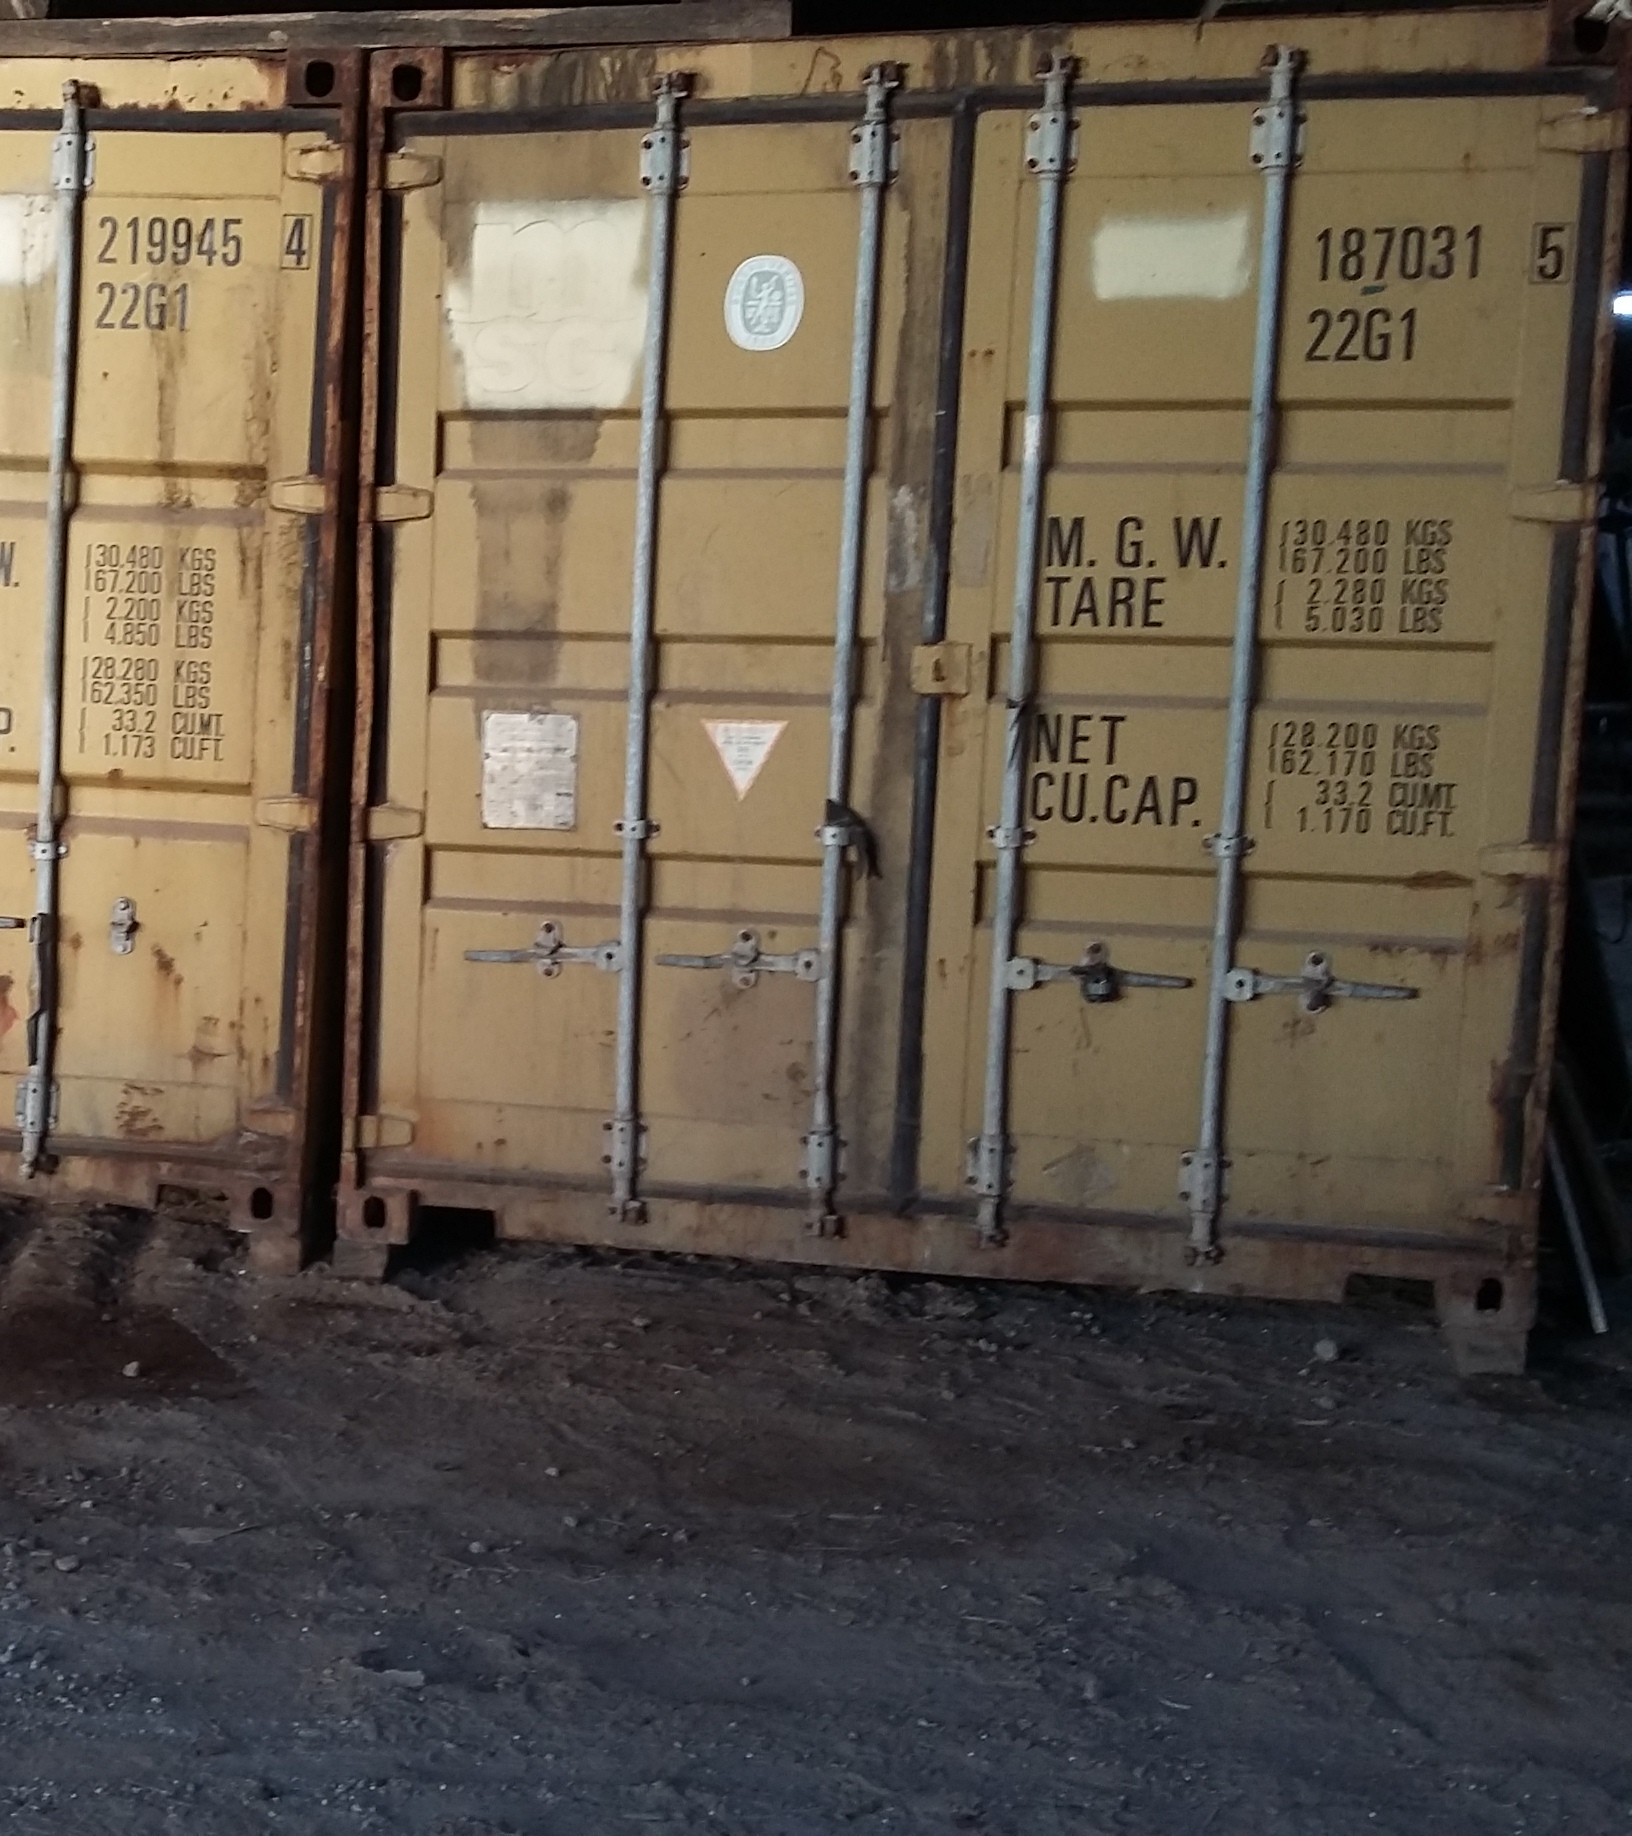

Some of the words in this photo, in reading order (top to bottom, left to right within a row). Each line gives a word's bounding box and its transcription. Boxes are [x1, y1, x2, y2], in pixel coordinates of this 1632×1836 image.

[98, 216, 242, 267] 219945
[285, 217, 306, 266] 4
[1316, 224, 1483, 282] 187031
[1534, 226, 1566, 280] 5
[96, 282, 189, 332] 22G1
[1305, 306, 1417, 362] 22G1
[1293, 519, 1389, 547] 30.480
[1405, 519, 1453, 546] KGS
[95, 544, 163, 570] 30.480
[178, 546, 216, 571] KGS
[1291, 547, 1387, 575] 67.200
[1403, 548, 1448, 575] LBS
[94, 569, 162, 594] 67.200
[178, 572, 215, 596] LBS
[1306, 578, 1386, 605] 2.280
[1401, 578, 1449, 606] KGS
[106, 596, 161, 621] 2.200
[176, 600, 214, 624] KGS
[1045, 576, 1166, 628] TARE
[1305, 606, 1384, 634] 5.030
[1399, 606, 1444, 634] LBS
[104, 622, 160, 647] 4.850
[175, 624, 213, 649] LBS
[91, 656, 159, 681] 28.280
[173, 660, 212, 684] KGS
[90, 680, 158, 706] 62.350
[173, 684, 210, 709] LBS
[112, 708, 156, 733] 33.2
[104, 733, 155, 759] 1.173
[1032, 713, 1127, 765] NET
[1283, 721, 1379, 750] 28.200
[1392, 724, 1441, 751] KGS
[1281, 749, 1377, 777] 62.170
[1390, 751, 1435, 778] LBS
[1032, 772, 1202, 827] CU.CAP.
[1316, 780, 1373, 807] 33.2
[1297, 806, 1372, 835] 1.170
